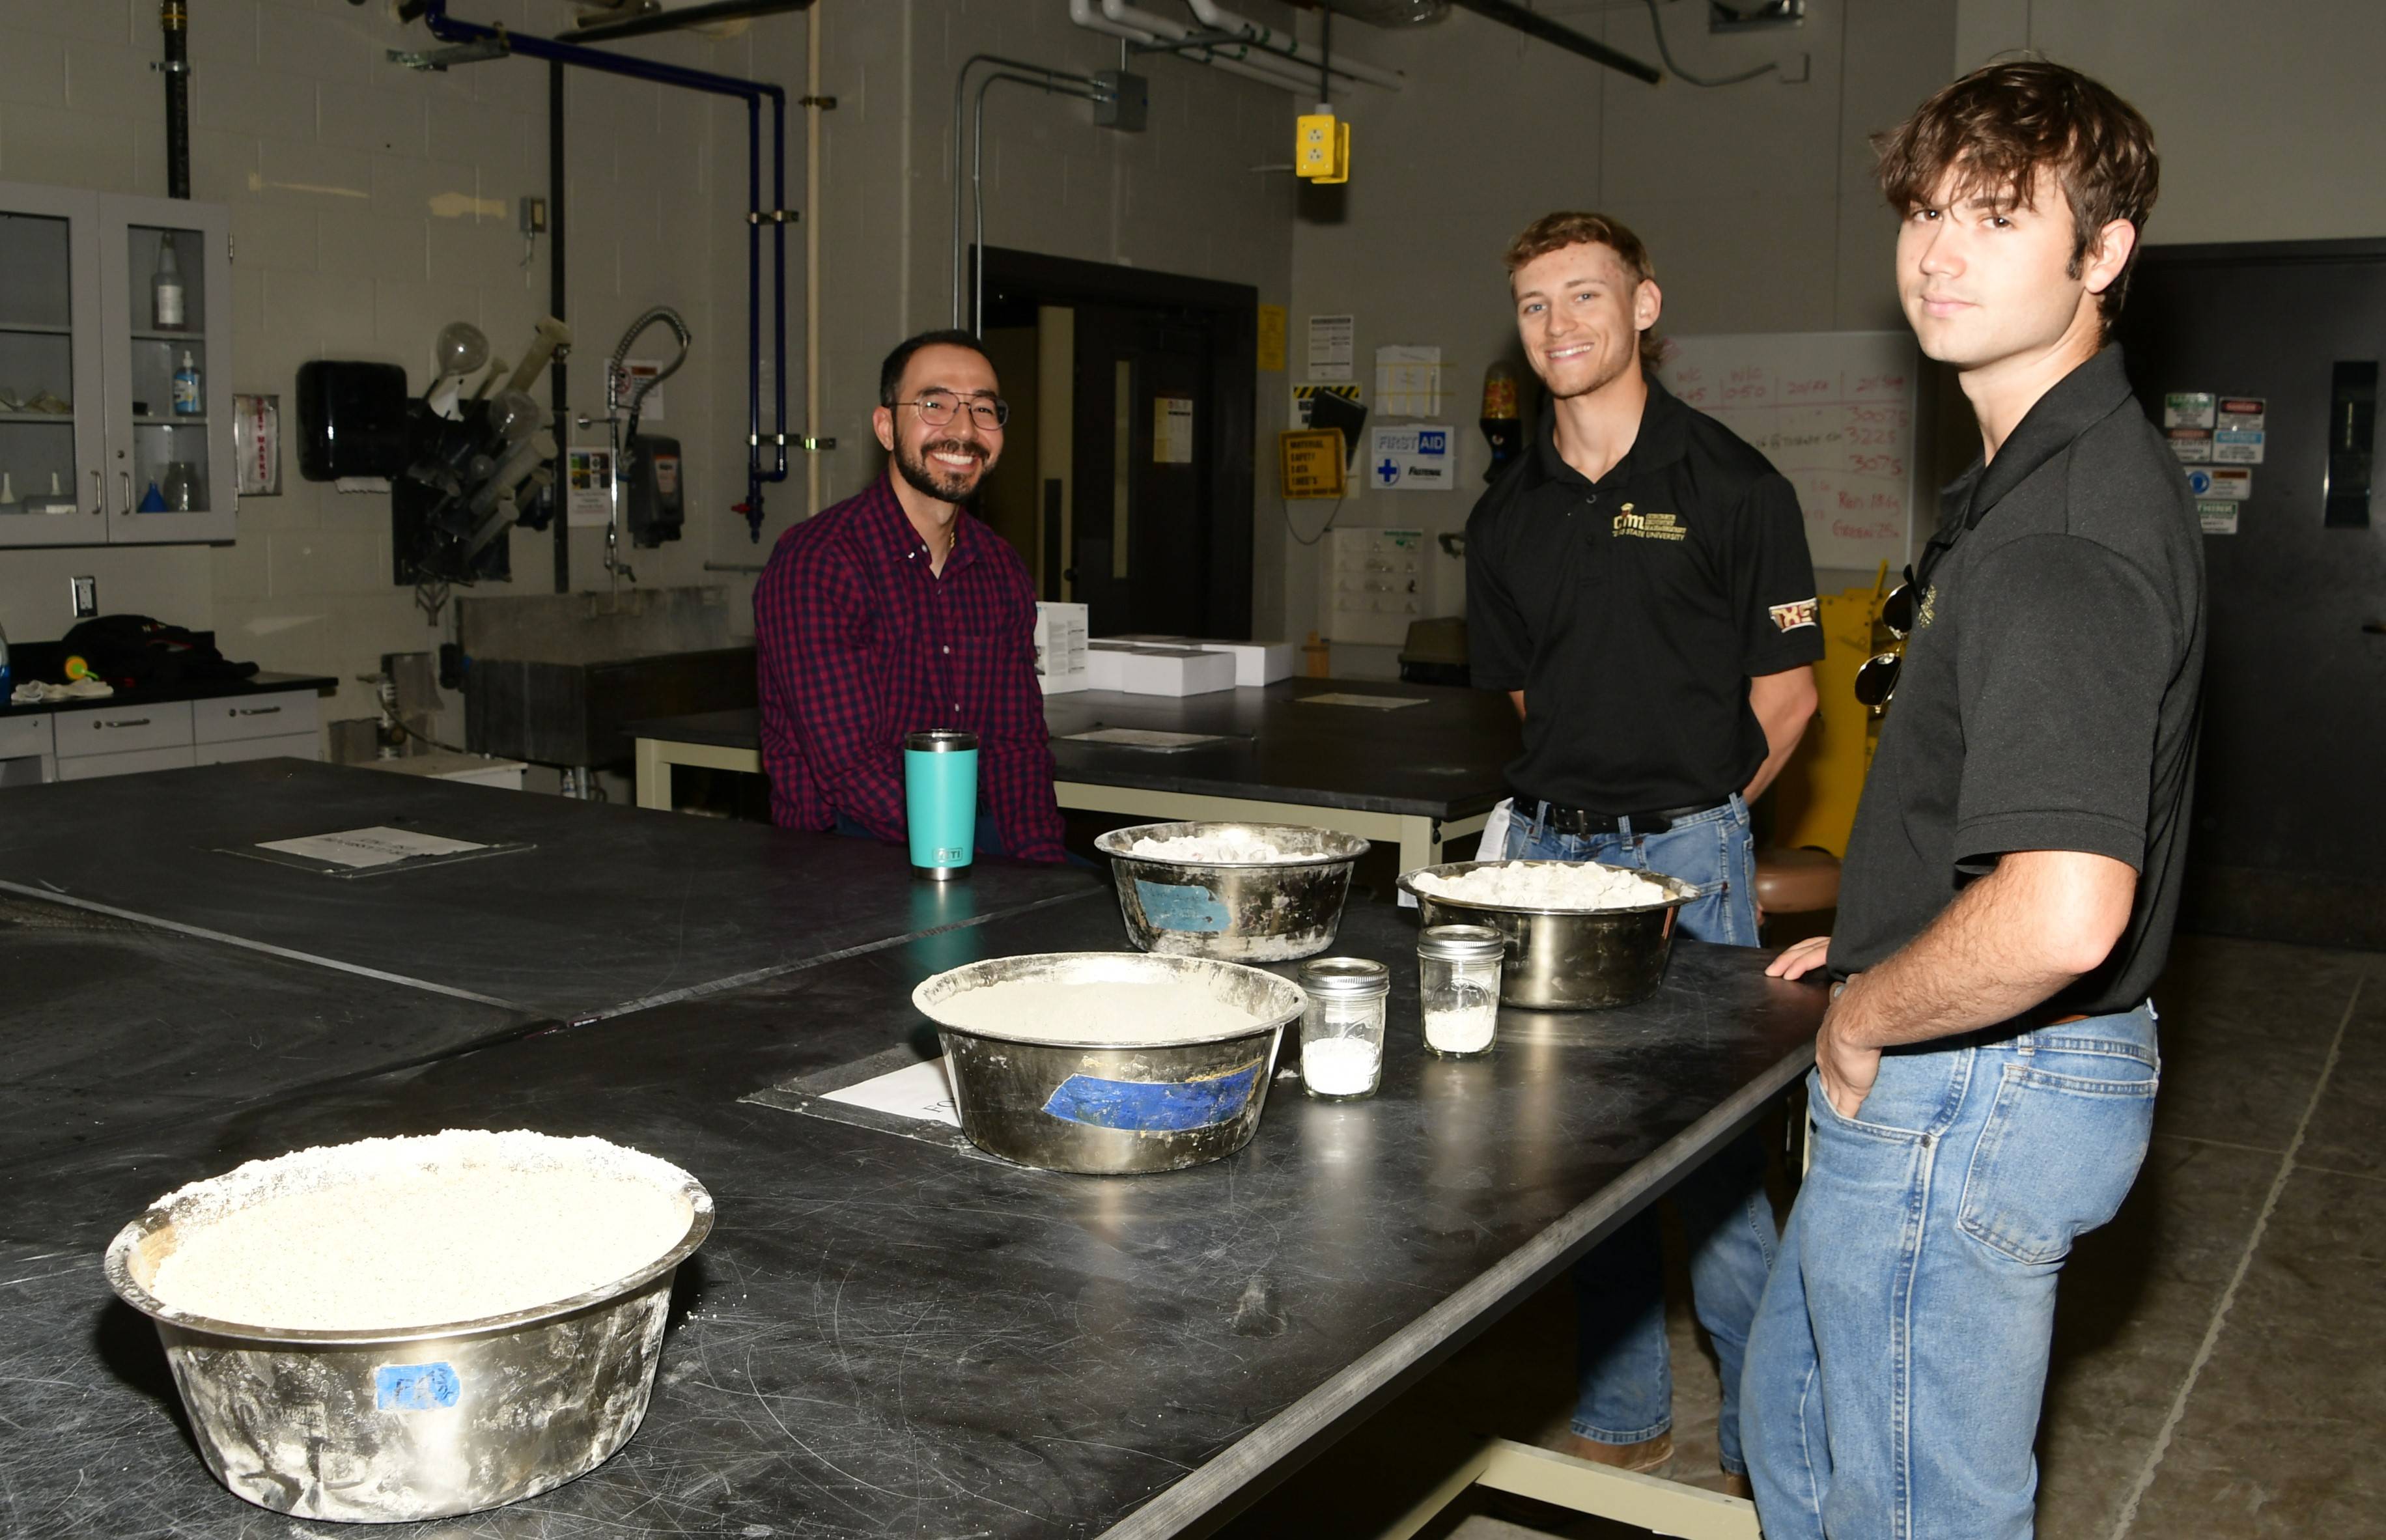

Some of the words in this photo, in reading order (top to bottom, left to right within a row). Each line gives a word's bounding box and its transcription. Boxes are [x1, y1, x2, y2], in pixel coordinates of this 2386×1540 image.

[1380, 436, 1418, 450] FIRST
[1421, 435, 1444, 451] AID
[257, 436, 266, 480] MASKS
[1626, 528, 1645, 538] STATE
[1646, 531, 1685, 541] UNIVERSITY
